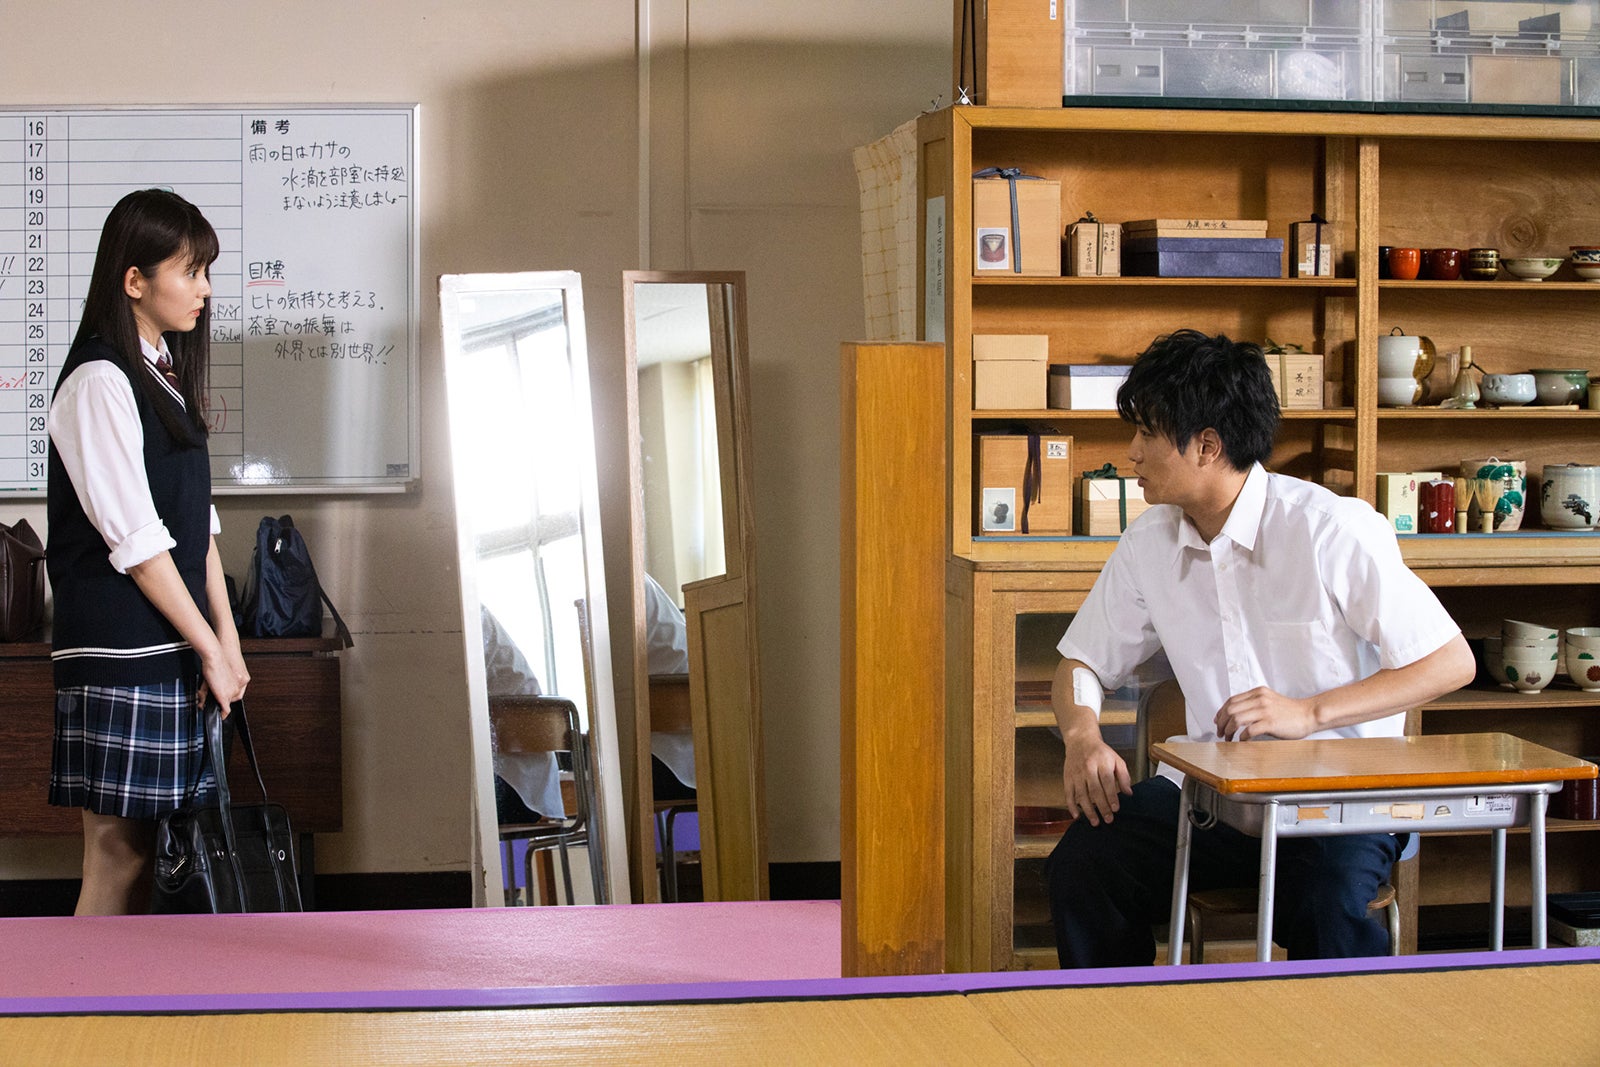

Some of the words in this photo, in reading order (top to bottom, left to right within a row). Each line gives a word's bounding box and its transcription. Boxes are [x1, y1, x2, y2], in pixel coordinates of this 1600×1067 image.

[29, 121, 44, 136] 16
[251, 119, 290, 135] 備考
[29, 143, 43, 157] 17
[249, 140, 351, 163] 雨の日はカサの
[29, 166, 44, 181] 18
[29, 189, 44, 204] 19
[28, 211, 44, 226] 20
[28, 234, 42, 249] 21
[28, 257, 44, 272] 22
[249, 260, 285, 280] 目標
[28, 280, 44, 294] 23
[28, 303, 44, 317] 24
[28, 325, 44, 339] 25
[247, 314, 355, 337] 茶室での振舞は
[29, 347, 45, 362] 26
[29, 371, 44, 385] 27
[29, 394, 45, 408] 28
[29, 416, 45, 431] 29
[30, 439, 46, 454] 30
[30, 463, 44, 477] 31
